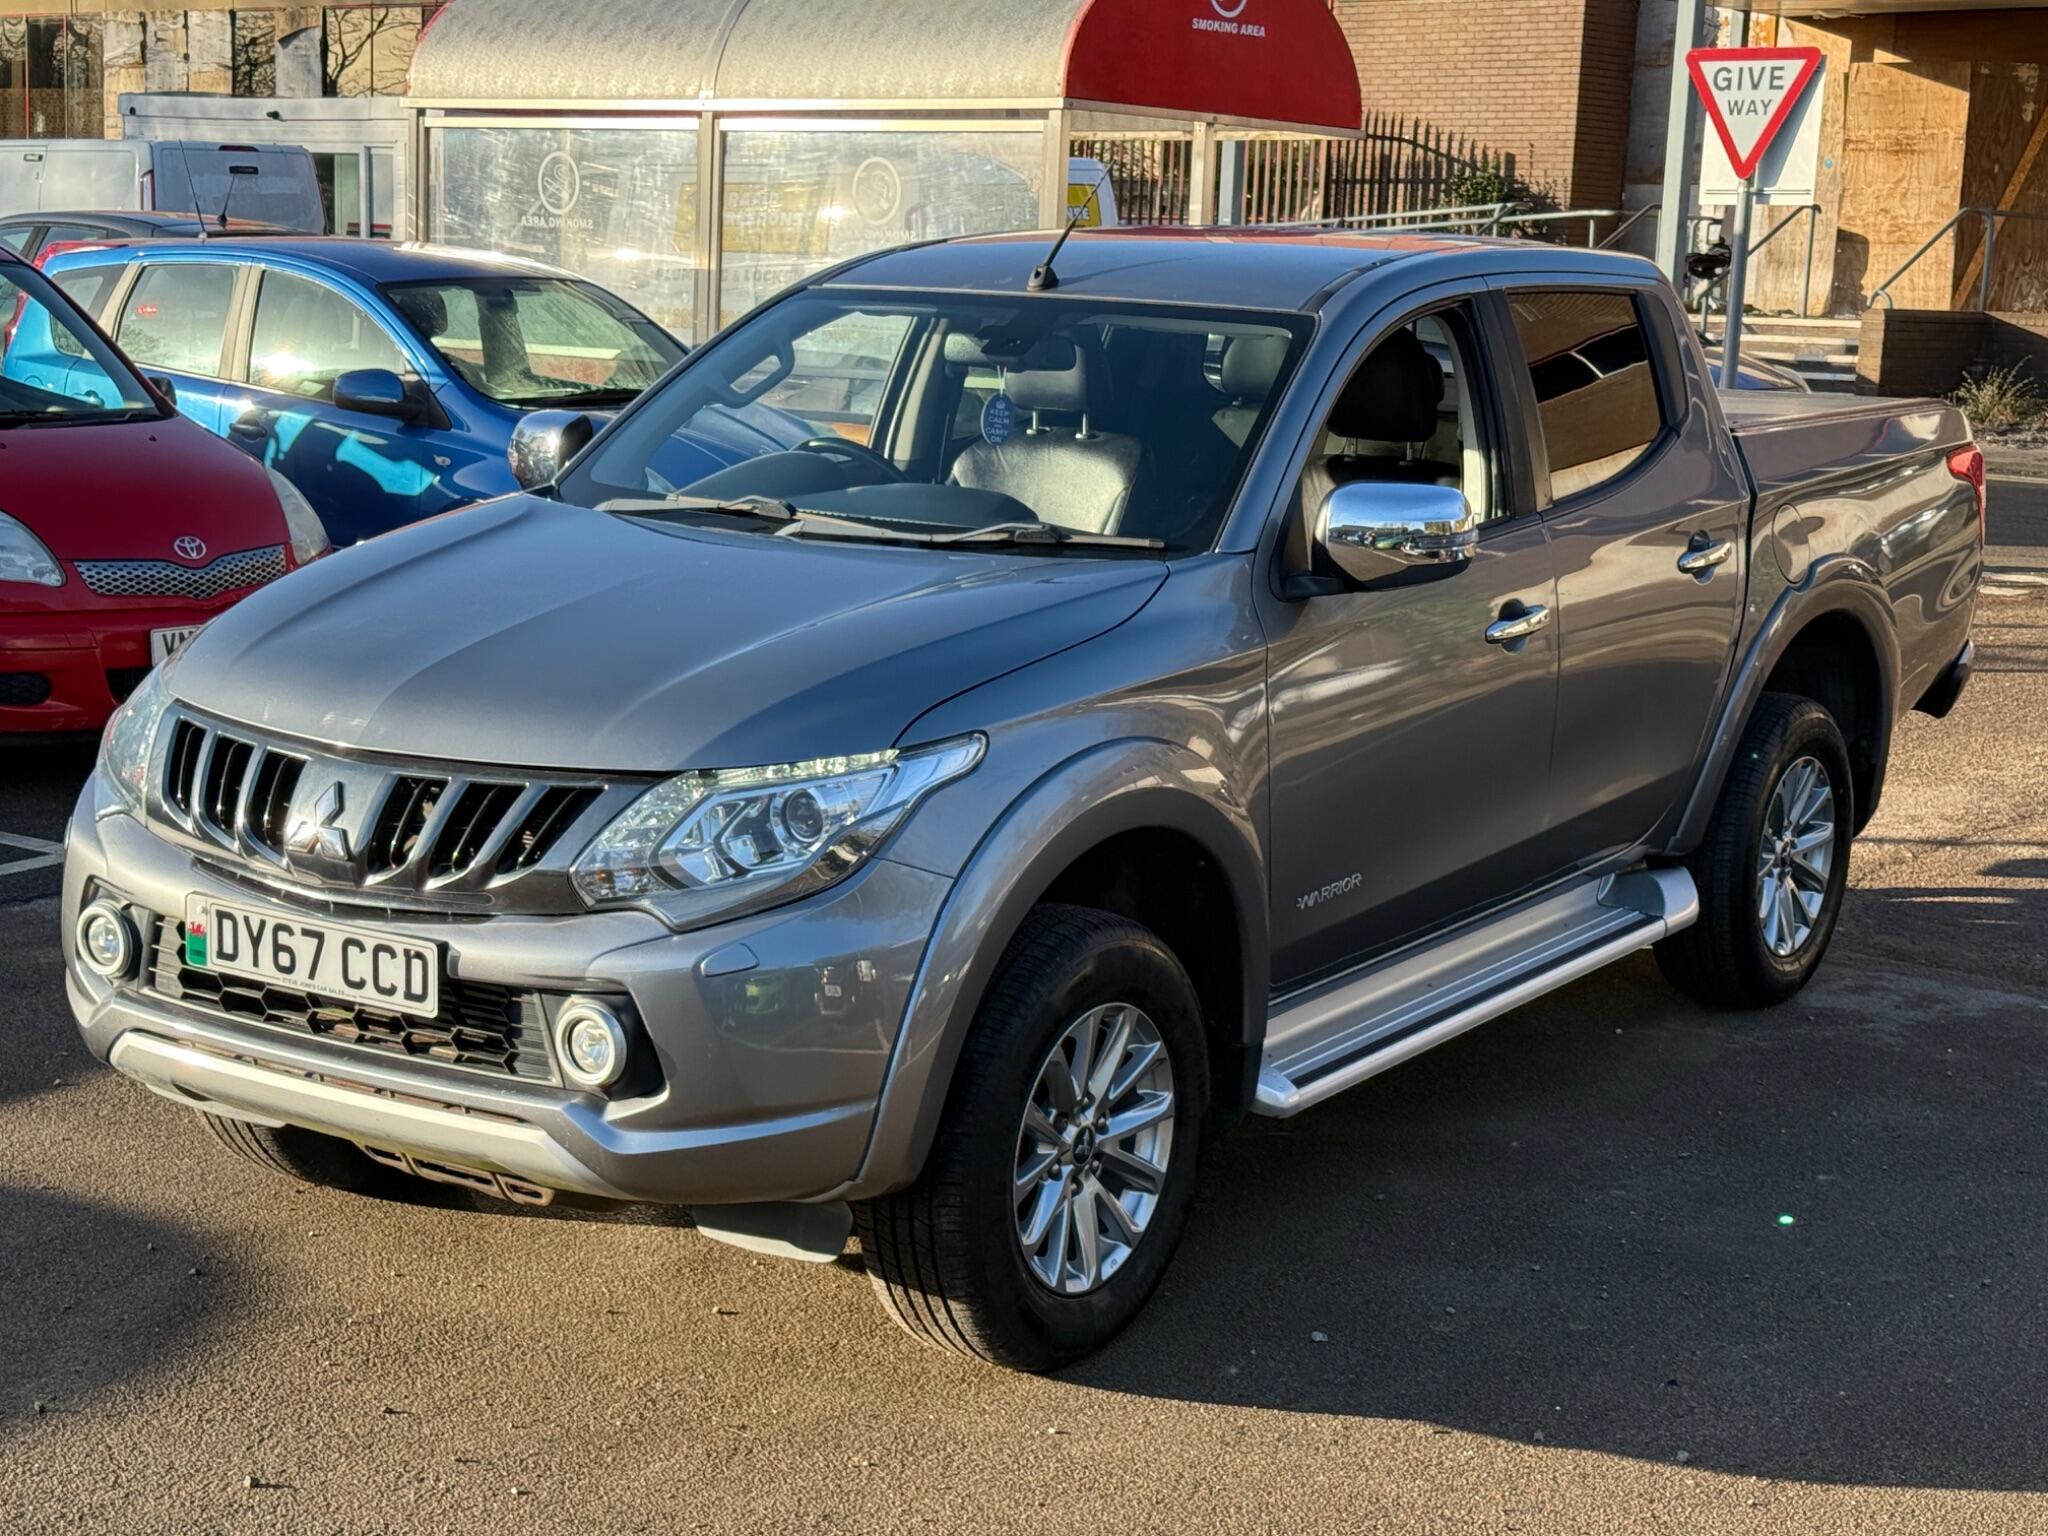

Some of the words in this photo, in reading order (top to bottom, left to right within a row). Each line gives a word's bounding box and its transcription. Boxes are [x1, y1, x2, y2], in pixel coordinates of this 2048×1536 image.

[1192, 17, 1238, 34] SMOKING
[1240, 24, 1265, 37] AREA
[1713, 66, 1785, 91] GIVE
[1727, 99, 1772, 116] WAY
[1296, 872, 1362, 910] WARRIOR
[215, 909, 325, 981] DY67
[341, 936, 429, 1004] CCD
